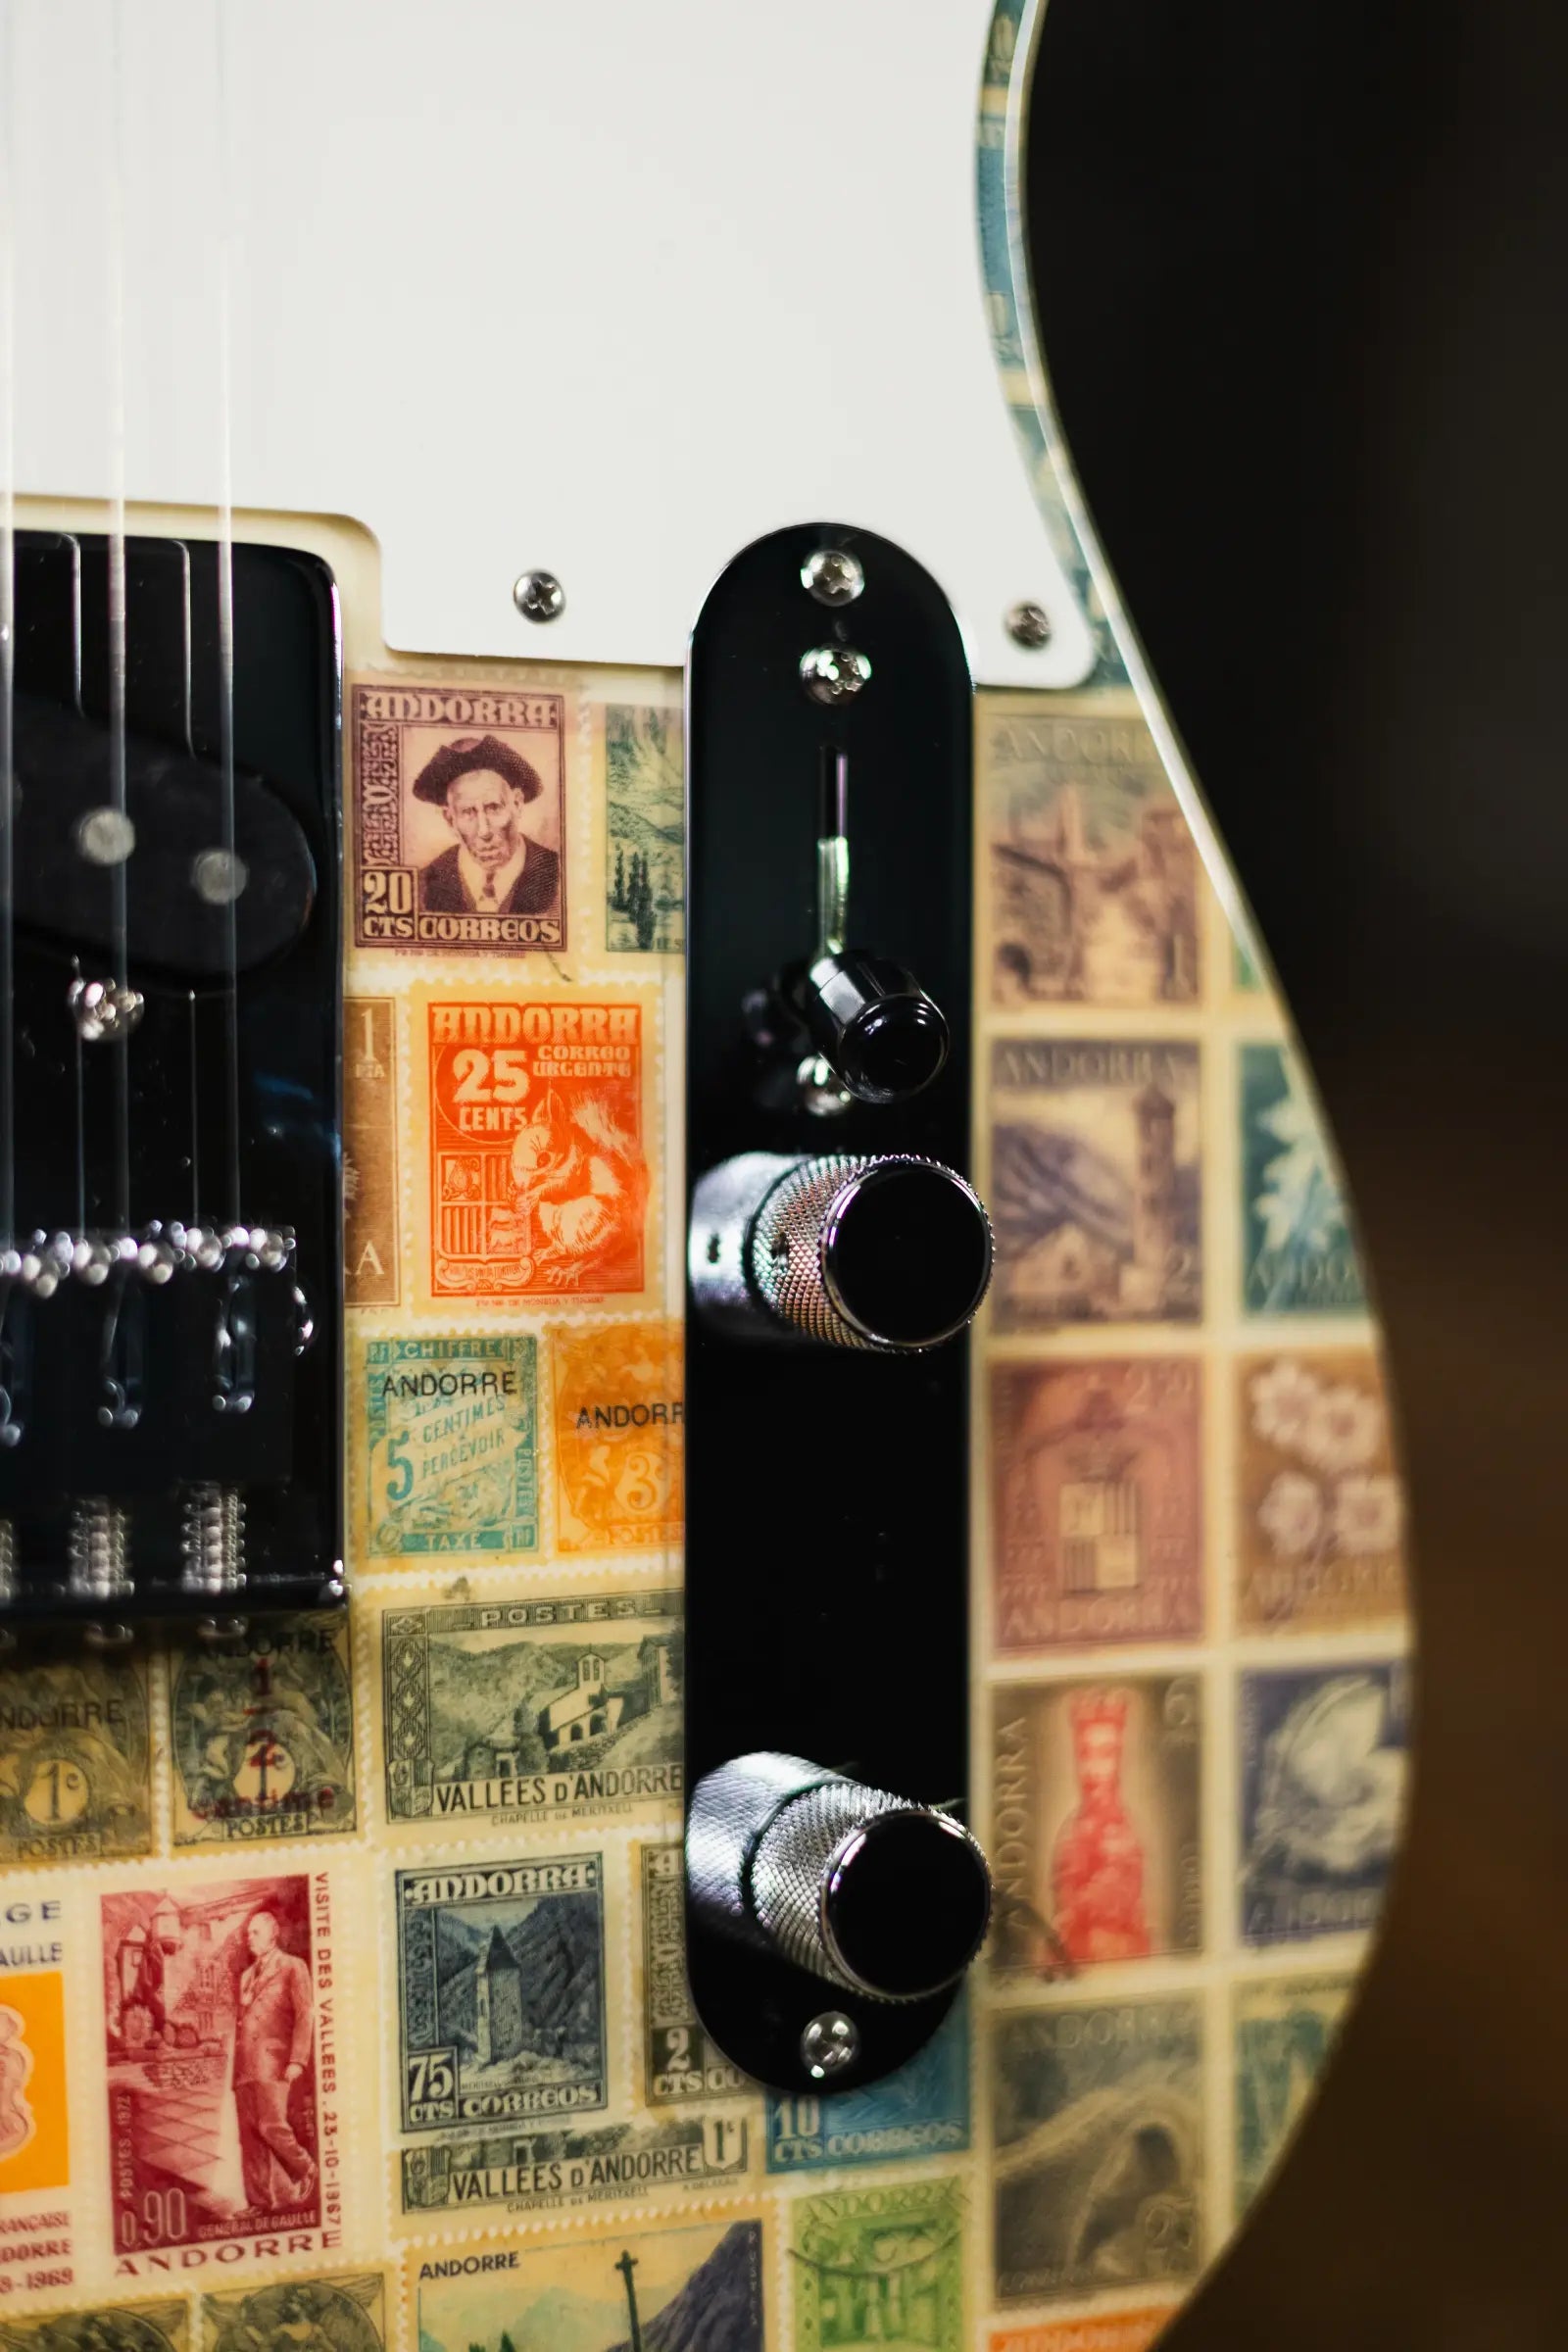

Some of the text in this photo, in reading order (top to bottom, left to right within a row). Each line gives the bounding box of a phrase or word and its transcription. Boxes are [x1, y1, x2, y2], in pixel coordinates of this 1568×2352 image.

[364, 691, 556, 727] ANDORRA
[364, 870, 412, 914] 20
[364, 916, 560, 943] CTS CORREOS
[432, 1005, 639, 1045] ANDORRA
[452, 1045, 630, 1104] 25 CORREO
[533, 1061, 631, 1078] URGENTE
[459, 1105, 527, 1131] CENTS
[404, 1341, 496, 1358] CHIFFRE
[381, 1371, 517, 1397] ANDORRE
[423, 1395, 506, 1444] CENTIMES
[386, 1431, 414, 1500] 5
[424, 1532, 481, 1551] TAXE
[481, 1599, 637, 1627] POSTES
[437, 1778, 546, 1813] VALLEES
[226, 1814, 304, 1839] POSTES
[414, 1863, 587, 1904] ANDORRA
[315, 1871, 331, 1938] VISITE
[318, 1948, 333, 1990] DES
[318, 1997, 337, 2094] VALLEES
[666, 2027, 690, 2072] 2
[409, 2055, 454, 2103] 75
[653, 2070, 704, 2096] CTS
[409, 2100, 454, 2124] CTS
[464, 2084, 598, 2118] CORREOS
[774, 2138, 823, 2164] CTS
[452, 2164, 564, 2201] VALLEES
[115, 2230, 342, 2278] ANDORRE
[419, 2250, 520, 2280] ANDORRE
